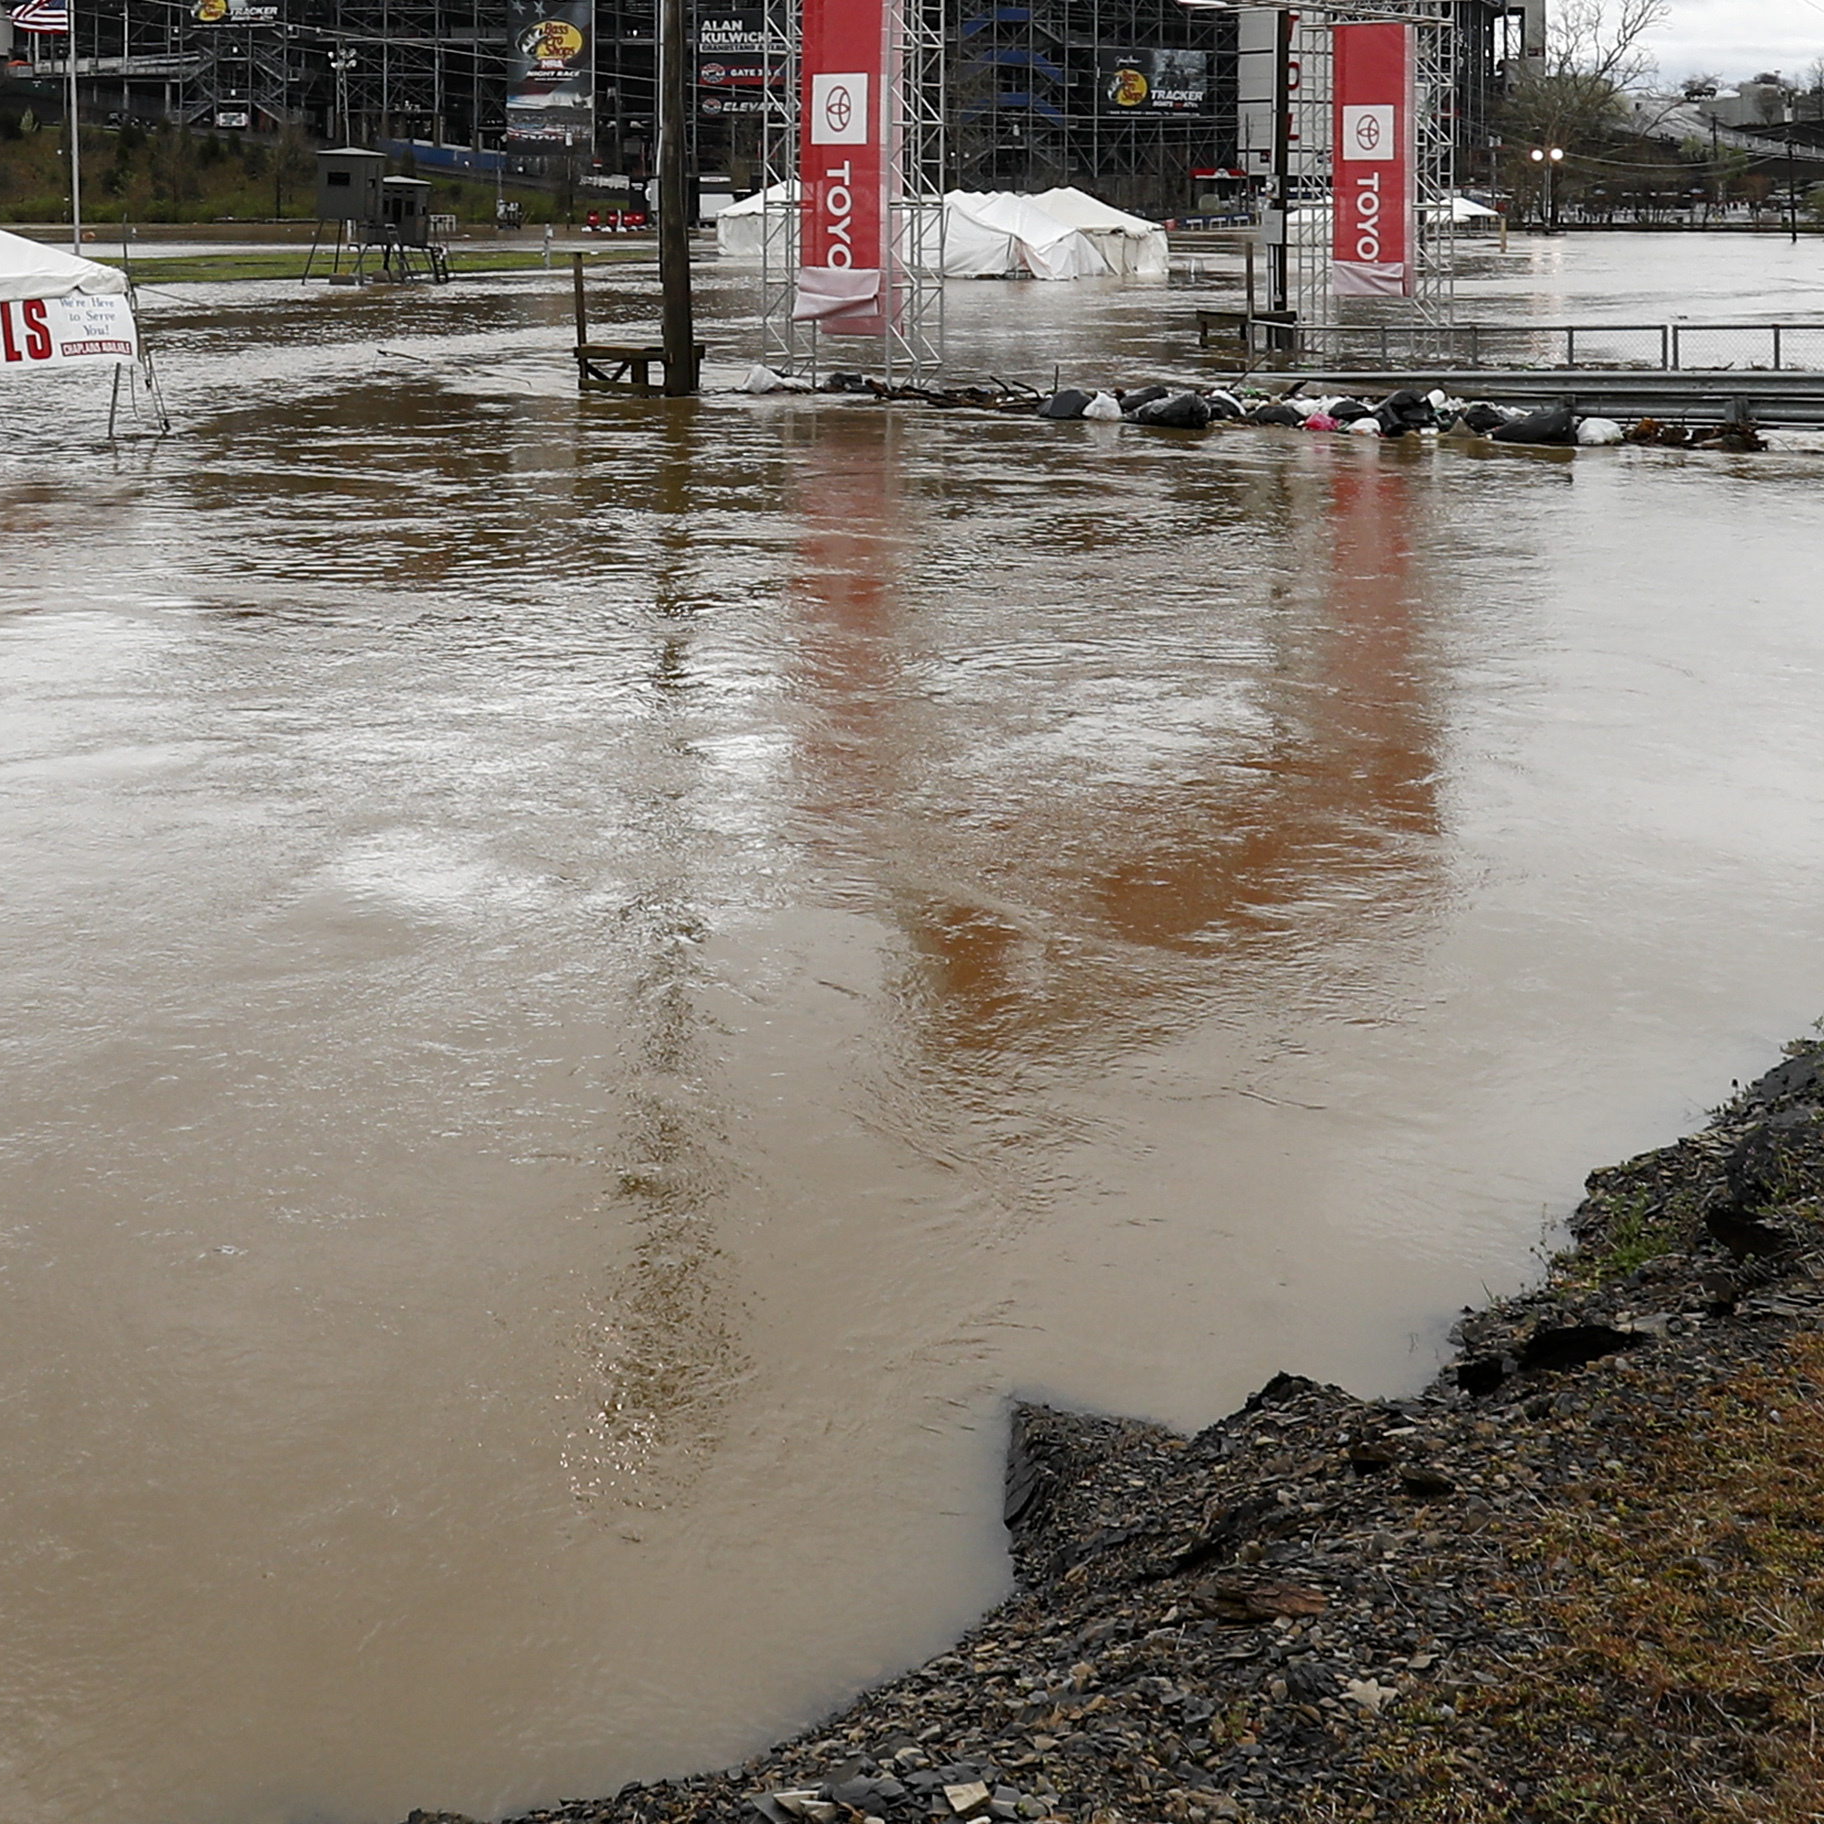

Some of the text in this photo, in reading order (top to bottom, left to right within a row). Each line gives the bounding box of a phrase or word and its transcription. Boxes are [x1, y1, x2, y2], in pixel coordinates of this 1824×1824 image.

[229, 6, 278, 15] TRACKER
[543, 23, 569, 35] Bass
[701, 20, 743, 31] ALAN
[544, 35, 563, 46] Pro
[545, 45, 576, 59] Shops
[556, 70, 580, 78] RACE
[730, 69, 755, 77] GATE
[1150, 90, 1204, 101] TRACKER
[826, 160, 853, 269] TOYO
[1356, 171, 1380, 263] TOYO
[69, 310, 116, 322] to Serve
[83, 324, 110, 336] You!
